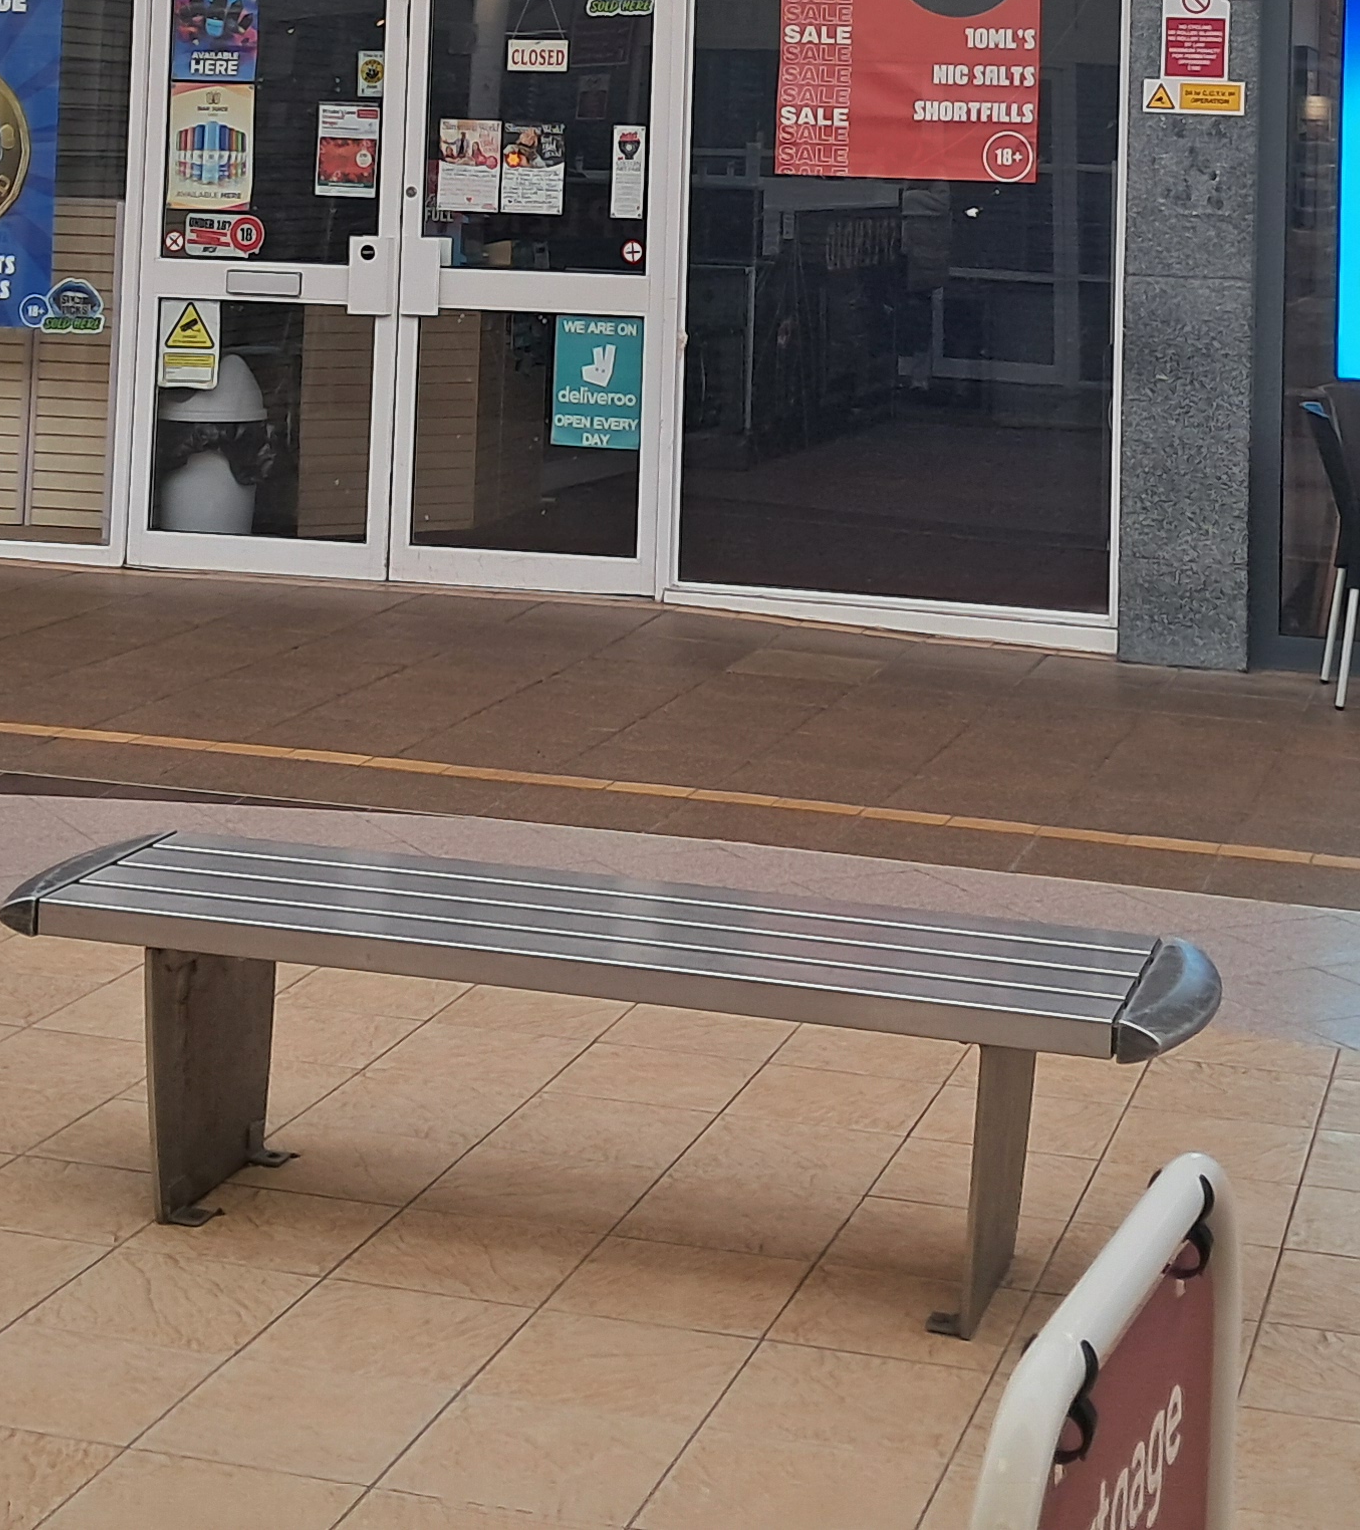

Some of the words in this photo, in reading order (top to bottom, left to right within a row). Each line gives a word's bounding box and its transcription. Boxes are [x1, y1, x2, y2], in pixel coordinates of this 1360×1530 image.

[591, 0, 619, 13] SOLD
[784, 5, 853, 24] SALE
[784, 25, 852, 44] SALE
[965, 27, 1036, 50] 10ML'S
[511, 48, 566, 66] CLOSED
[783, 45, 852, 64] SALE
[190, 60, 239, 75] HERE
[782, 65, 851, 85] SALE
[933, 64, 968, 85] NIC
[972, 65, 1035, 87] SALTS
[781, 86, 851, 106] SALE
[780, 107, 849, 126] SALE
[913, 100, 1034, 124] SHORTFILLS
[779, 125, 849, 144] SALE
[778, 145, 849, 165] SALE
[994, 148, 1023, 166] 18+
[240, 227, 253, 242] 18
[44, 316, 71, 330] SOLD
[73, 317, 102, 331] HERE
[563, 320, 586, 333] WE
[587, 321, 615, 335] ARE
[617, 323, 638, 336] ON
[558, 385, 637, 407] deliveroo
[554, 414, 591, 429] OPEN
[593, 416, 639, 431] EVERY
[582, 432, 611, 447] DAY
